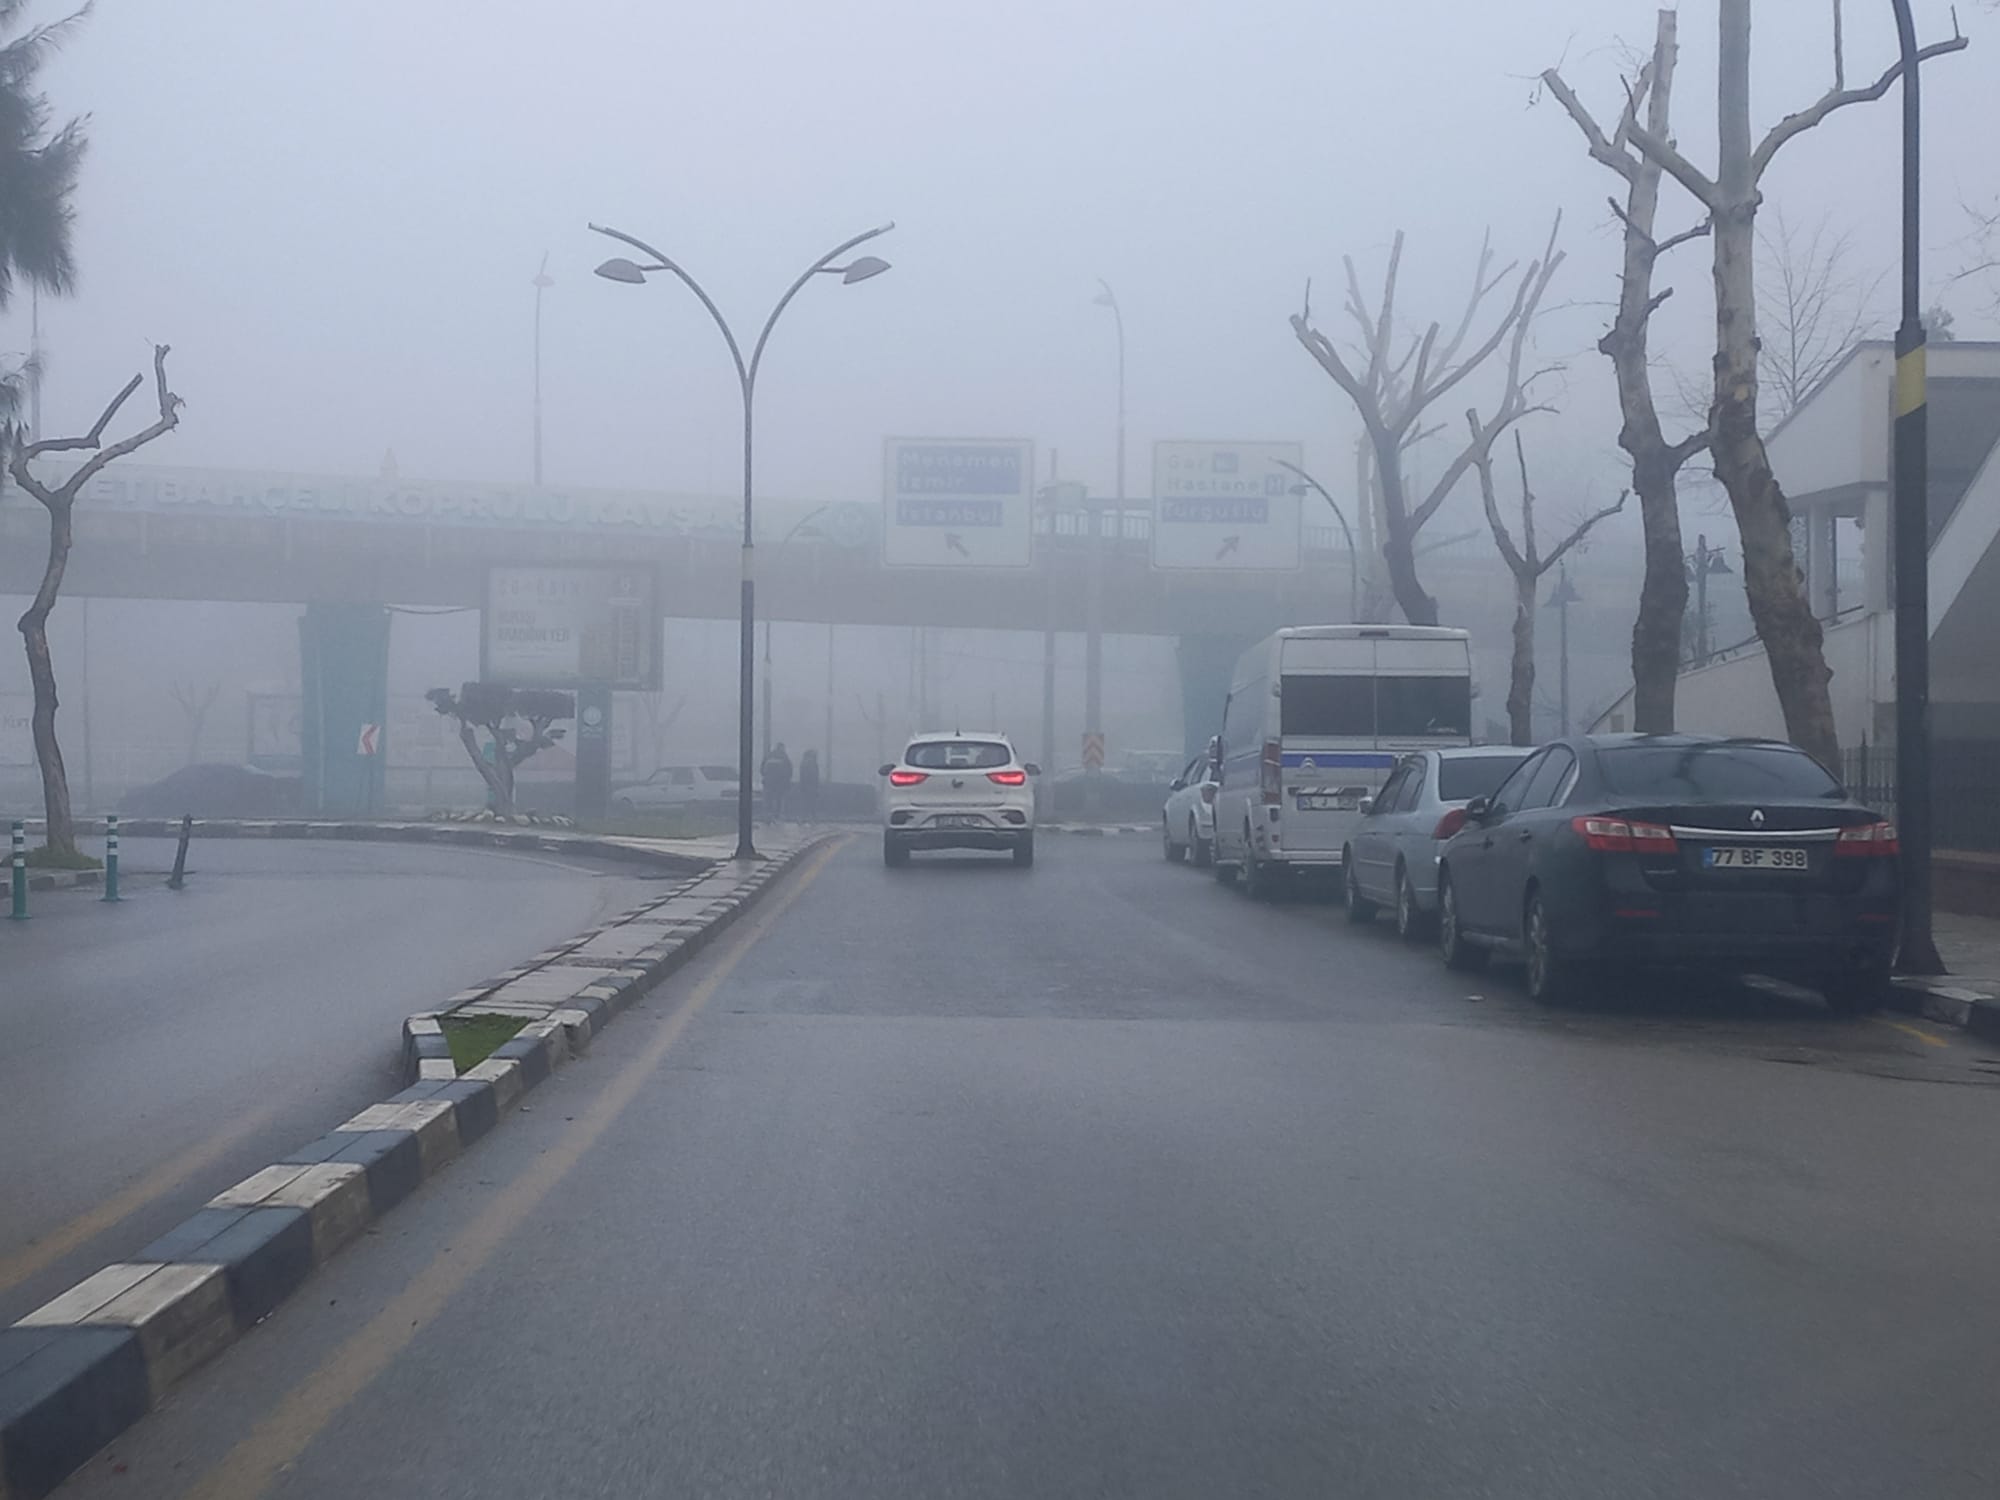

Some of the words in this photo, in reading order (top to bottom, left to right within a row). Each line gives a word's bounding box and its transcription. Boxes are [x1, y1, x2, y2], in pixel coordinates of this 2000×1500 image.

[1167, 476, 1260, 492] Hastane
[1712, 849, 1735, 865] 77
[1741, 849, 1765, 865] BF
[1771, 850, 1806, 867] 398
